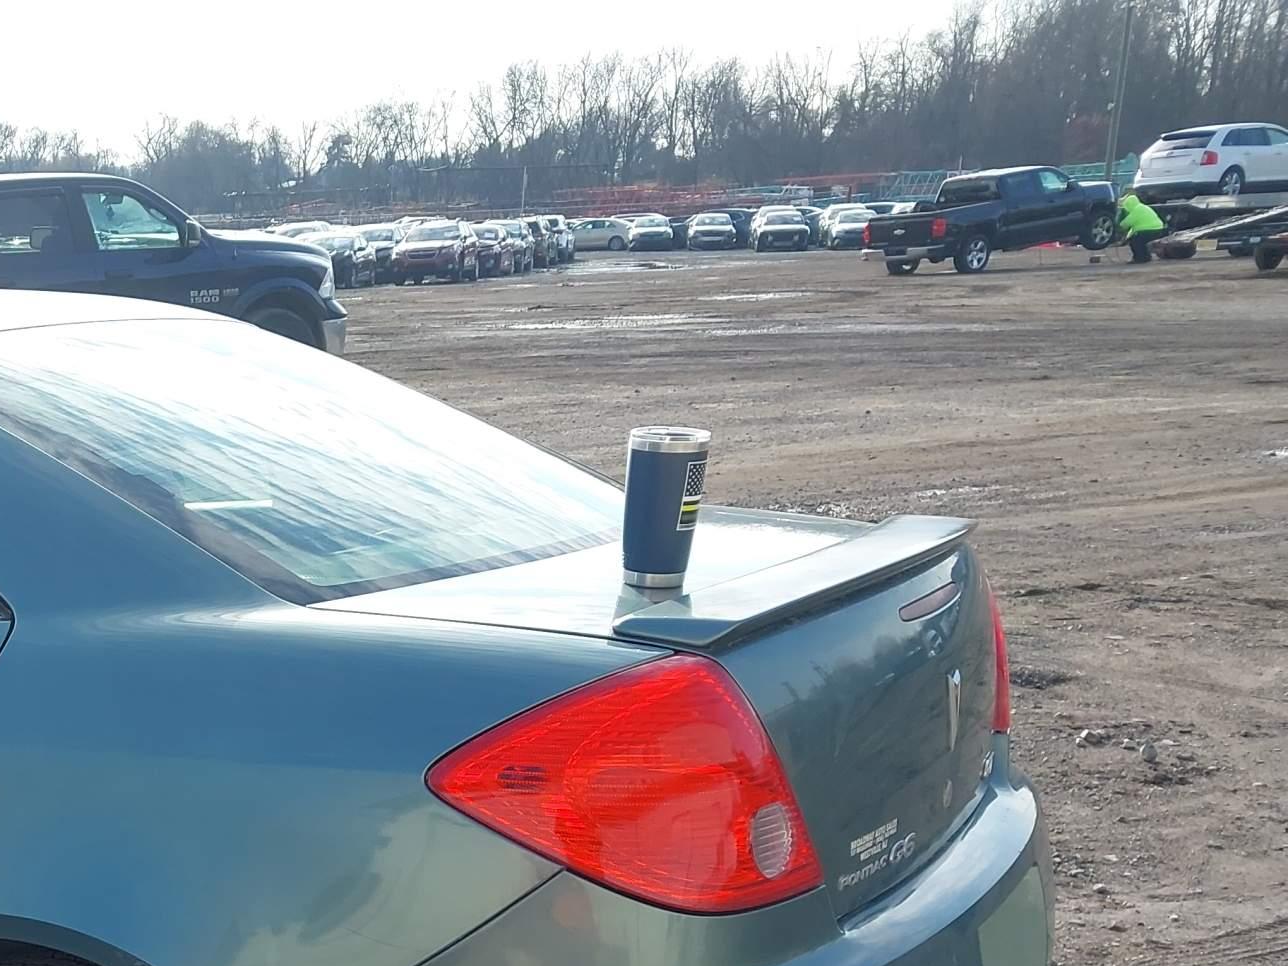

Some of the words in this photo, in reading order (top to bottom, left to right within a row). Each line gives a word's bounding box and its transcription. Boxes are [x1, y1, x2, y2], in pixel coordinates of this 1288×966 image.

[190, 289, 220, 297] RAM
[838, 854, 889, 891] PONTIAC
[889, 831, 918, 864] G6
